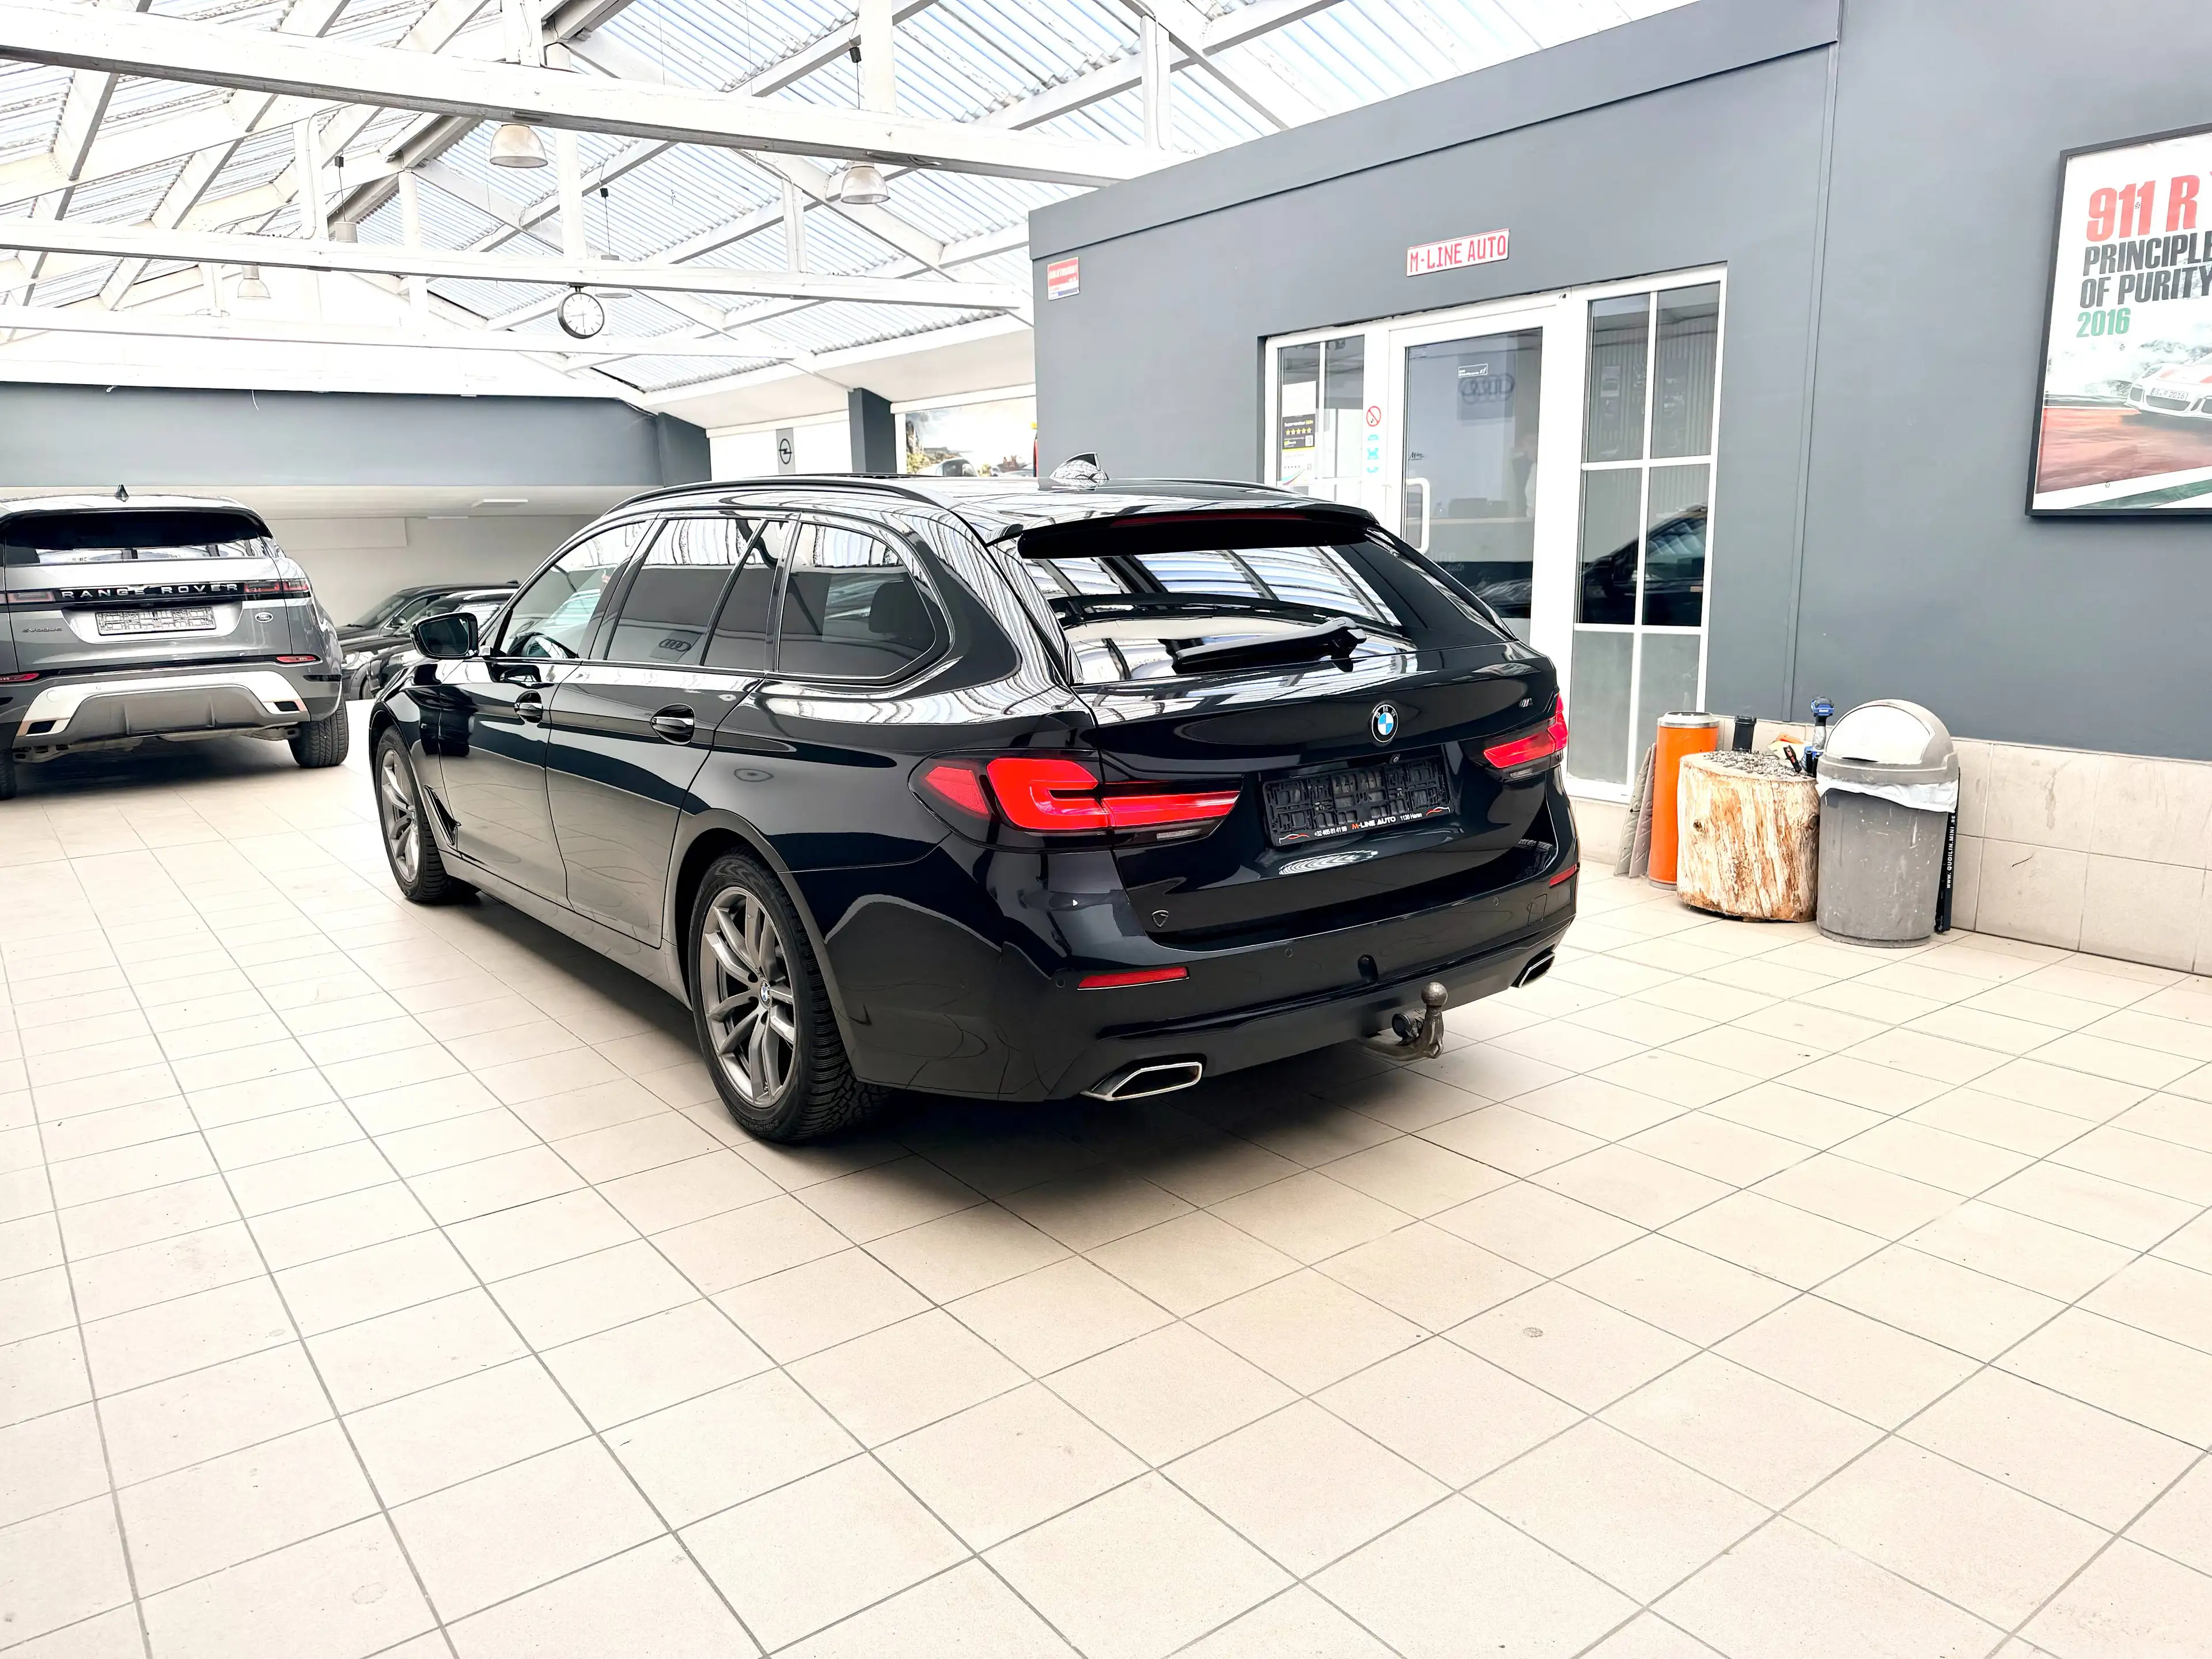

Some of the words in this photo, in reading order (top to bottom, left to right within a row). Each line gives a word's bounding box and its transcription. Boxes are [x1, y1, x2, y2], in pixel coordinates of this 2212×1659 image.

[2086, 180, 2156, 242] 911
[2166, 175, 2200, 232] R
[1411, 243, 1462, 272] M-LINE
[1468, 235, 1506, 262] AUTO
[2080, 276, 2112, 308] OF
[2118, 265, 2212, 305] PURITY
[2077, 308, 2131, 338] 2016
[62, 588, 145, 599] RANGE
[161, 583, 238, 594] ROVER
[1351, 820, 1376, 830] M-LINE
[1377, 816, 1396, 825] AUTO
